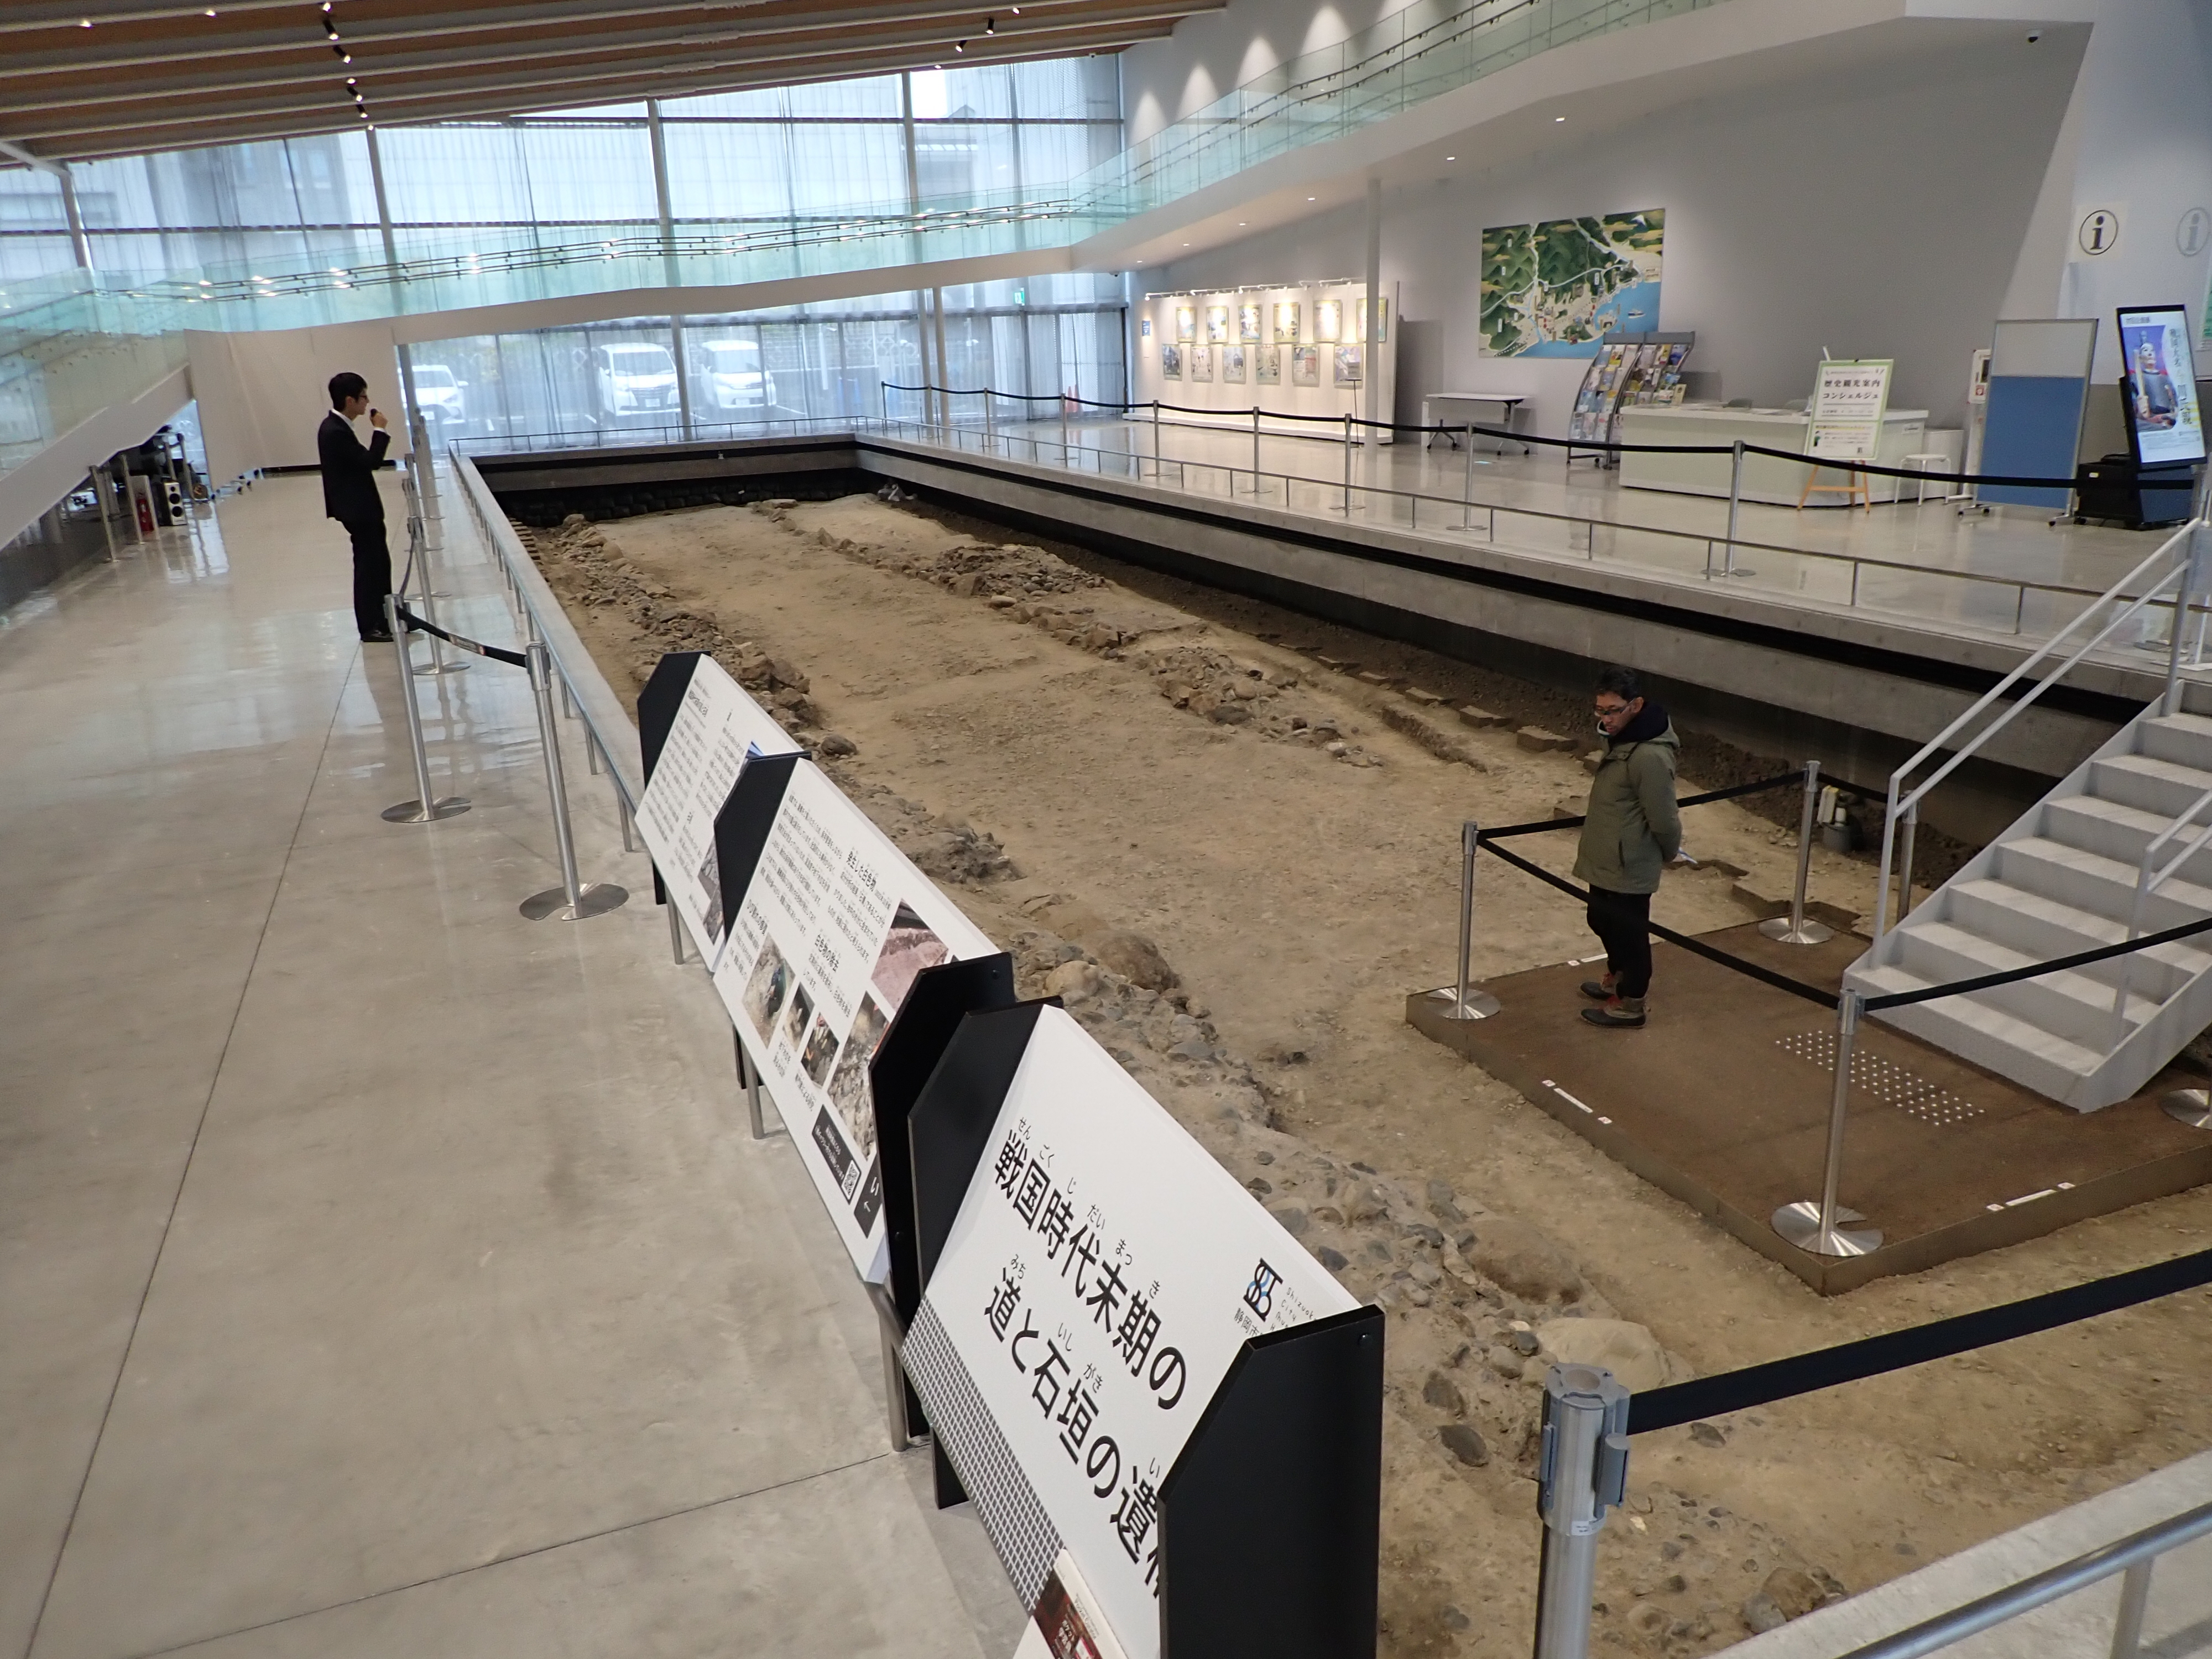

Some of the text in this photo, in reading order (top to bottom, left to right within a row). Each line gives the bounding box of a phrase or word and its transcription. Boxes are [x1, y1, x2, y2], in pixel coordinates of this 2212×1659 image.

[1019, 1117, 1031, 1140] せん
[1039, 1144, 1055, 1168] ごく
[1067, 1177, 1076, 1194] じ
[1087, 1204, 1105, 1230] だい
[995, 1129, 1186, 1410] 戦国時代末期の
[1011, 1254, 1026, 1279] みち
[1149, 1280, 1160, 1299] き
[1234, 1307, 1263, 1337] 静岡市
[1281, 1300, 1297, 1322] City
[1058, 1322, 1072, 1352] いし
[1083, 1363, 1103, 1393] がき
